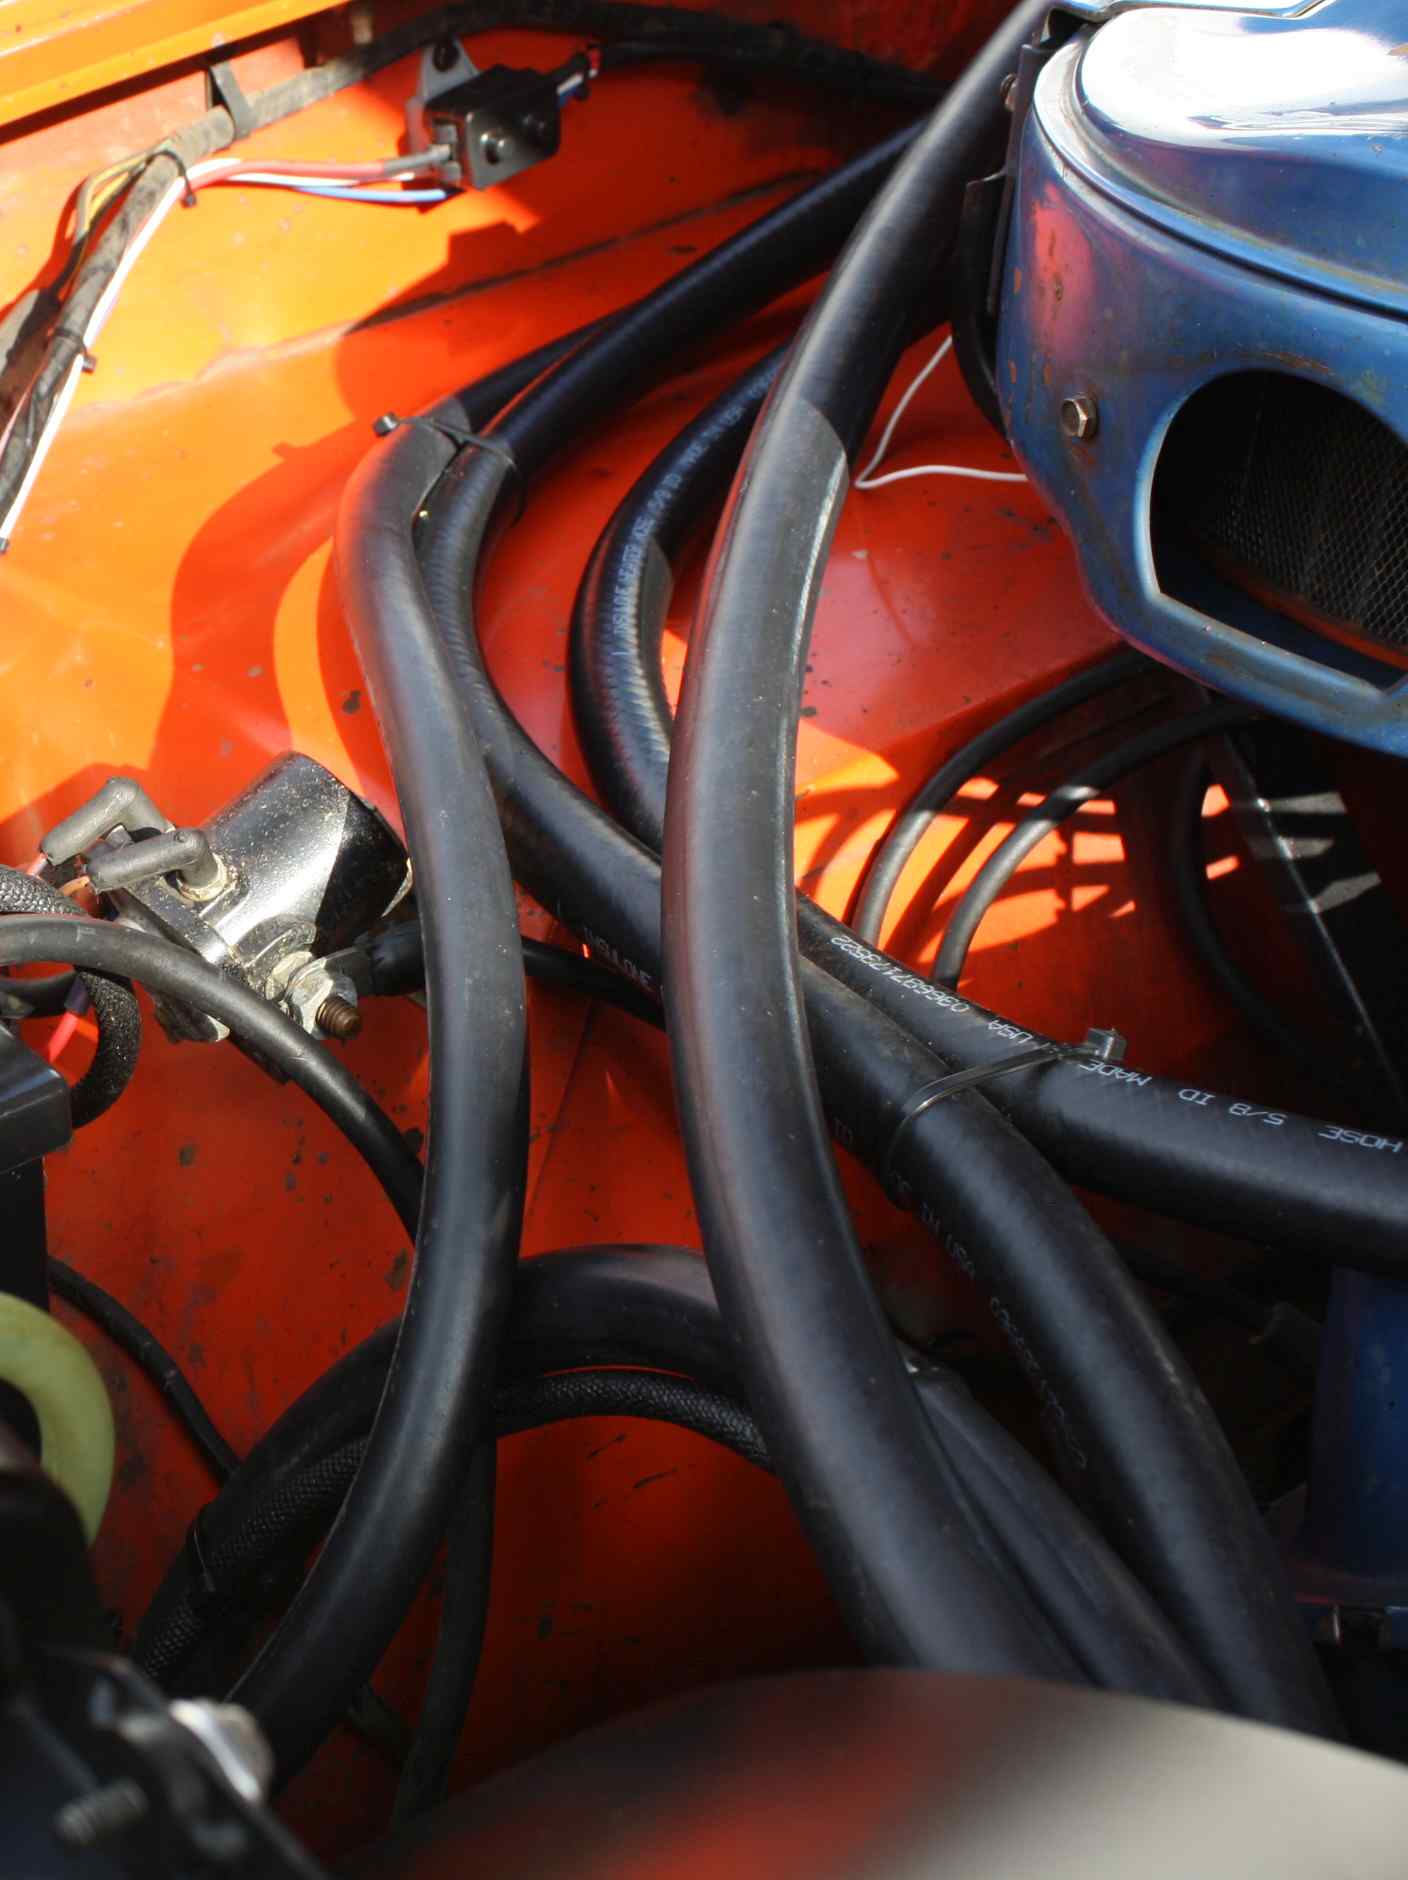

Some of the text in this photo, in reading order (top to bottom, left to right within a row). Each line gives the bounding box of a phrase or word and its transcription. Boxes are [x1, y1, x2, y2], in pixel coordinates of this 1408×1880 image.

[987, 1017, 1034, 1044] USA
[1079, 1057, 1404, 1152] HOSE 5/8 ID MADE
